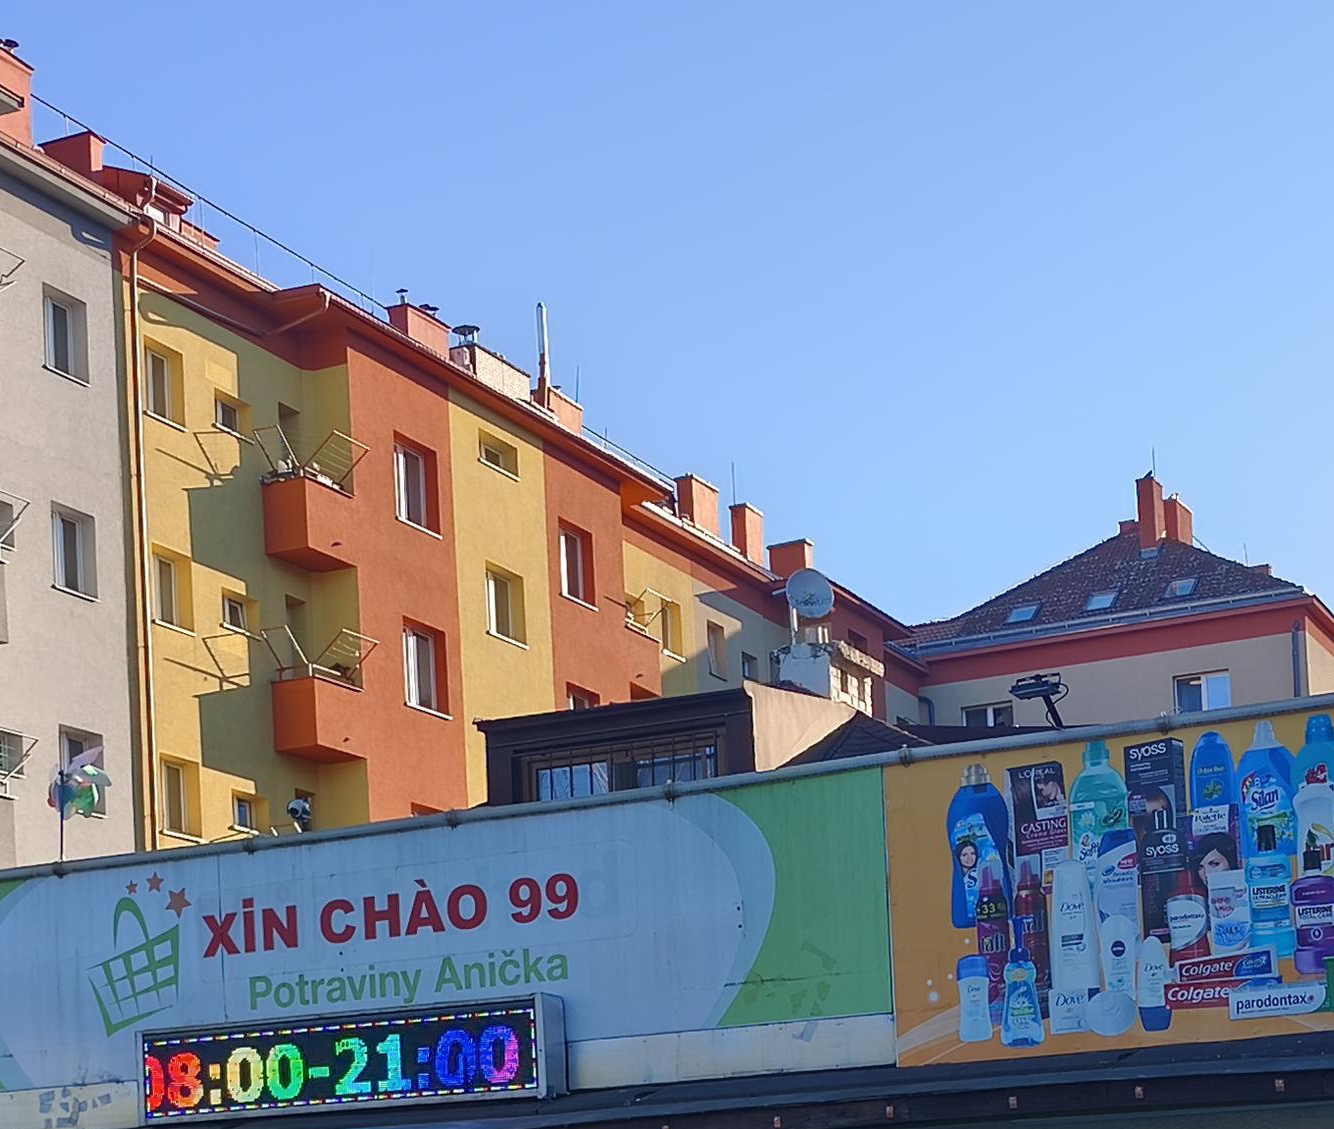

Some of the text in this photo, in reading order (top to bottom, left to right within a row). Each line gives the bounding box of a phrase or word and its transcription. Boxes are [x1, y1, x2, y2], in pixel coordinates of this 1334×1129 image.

[1251, 788, 1279, 811] Silan
[1021, 818, 1067, 834] CASTING
[320, 879, 488, 944] CHÀO
[509, 873, 579, 923] 99
[1060, 902, 1084, 913] Dove
[1144, 963, 1163, 973] Dove
[1182, 959, 1233, 977] Colgate
[249, 949, 569, 1011] Potraviny Anička
[1055, 994, 1085, 1007] Dove
[1168, 986, 1231, 1004] Colgate
[1236, 991, 1309, 1014] parodontax
